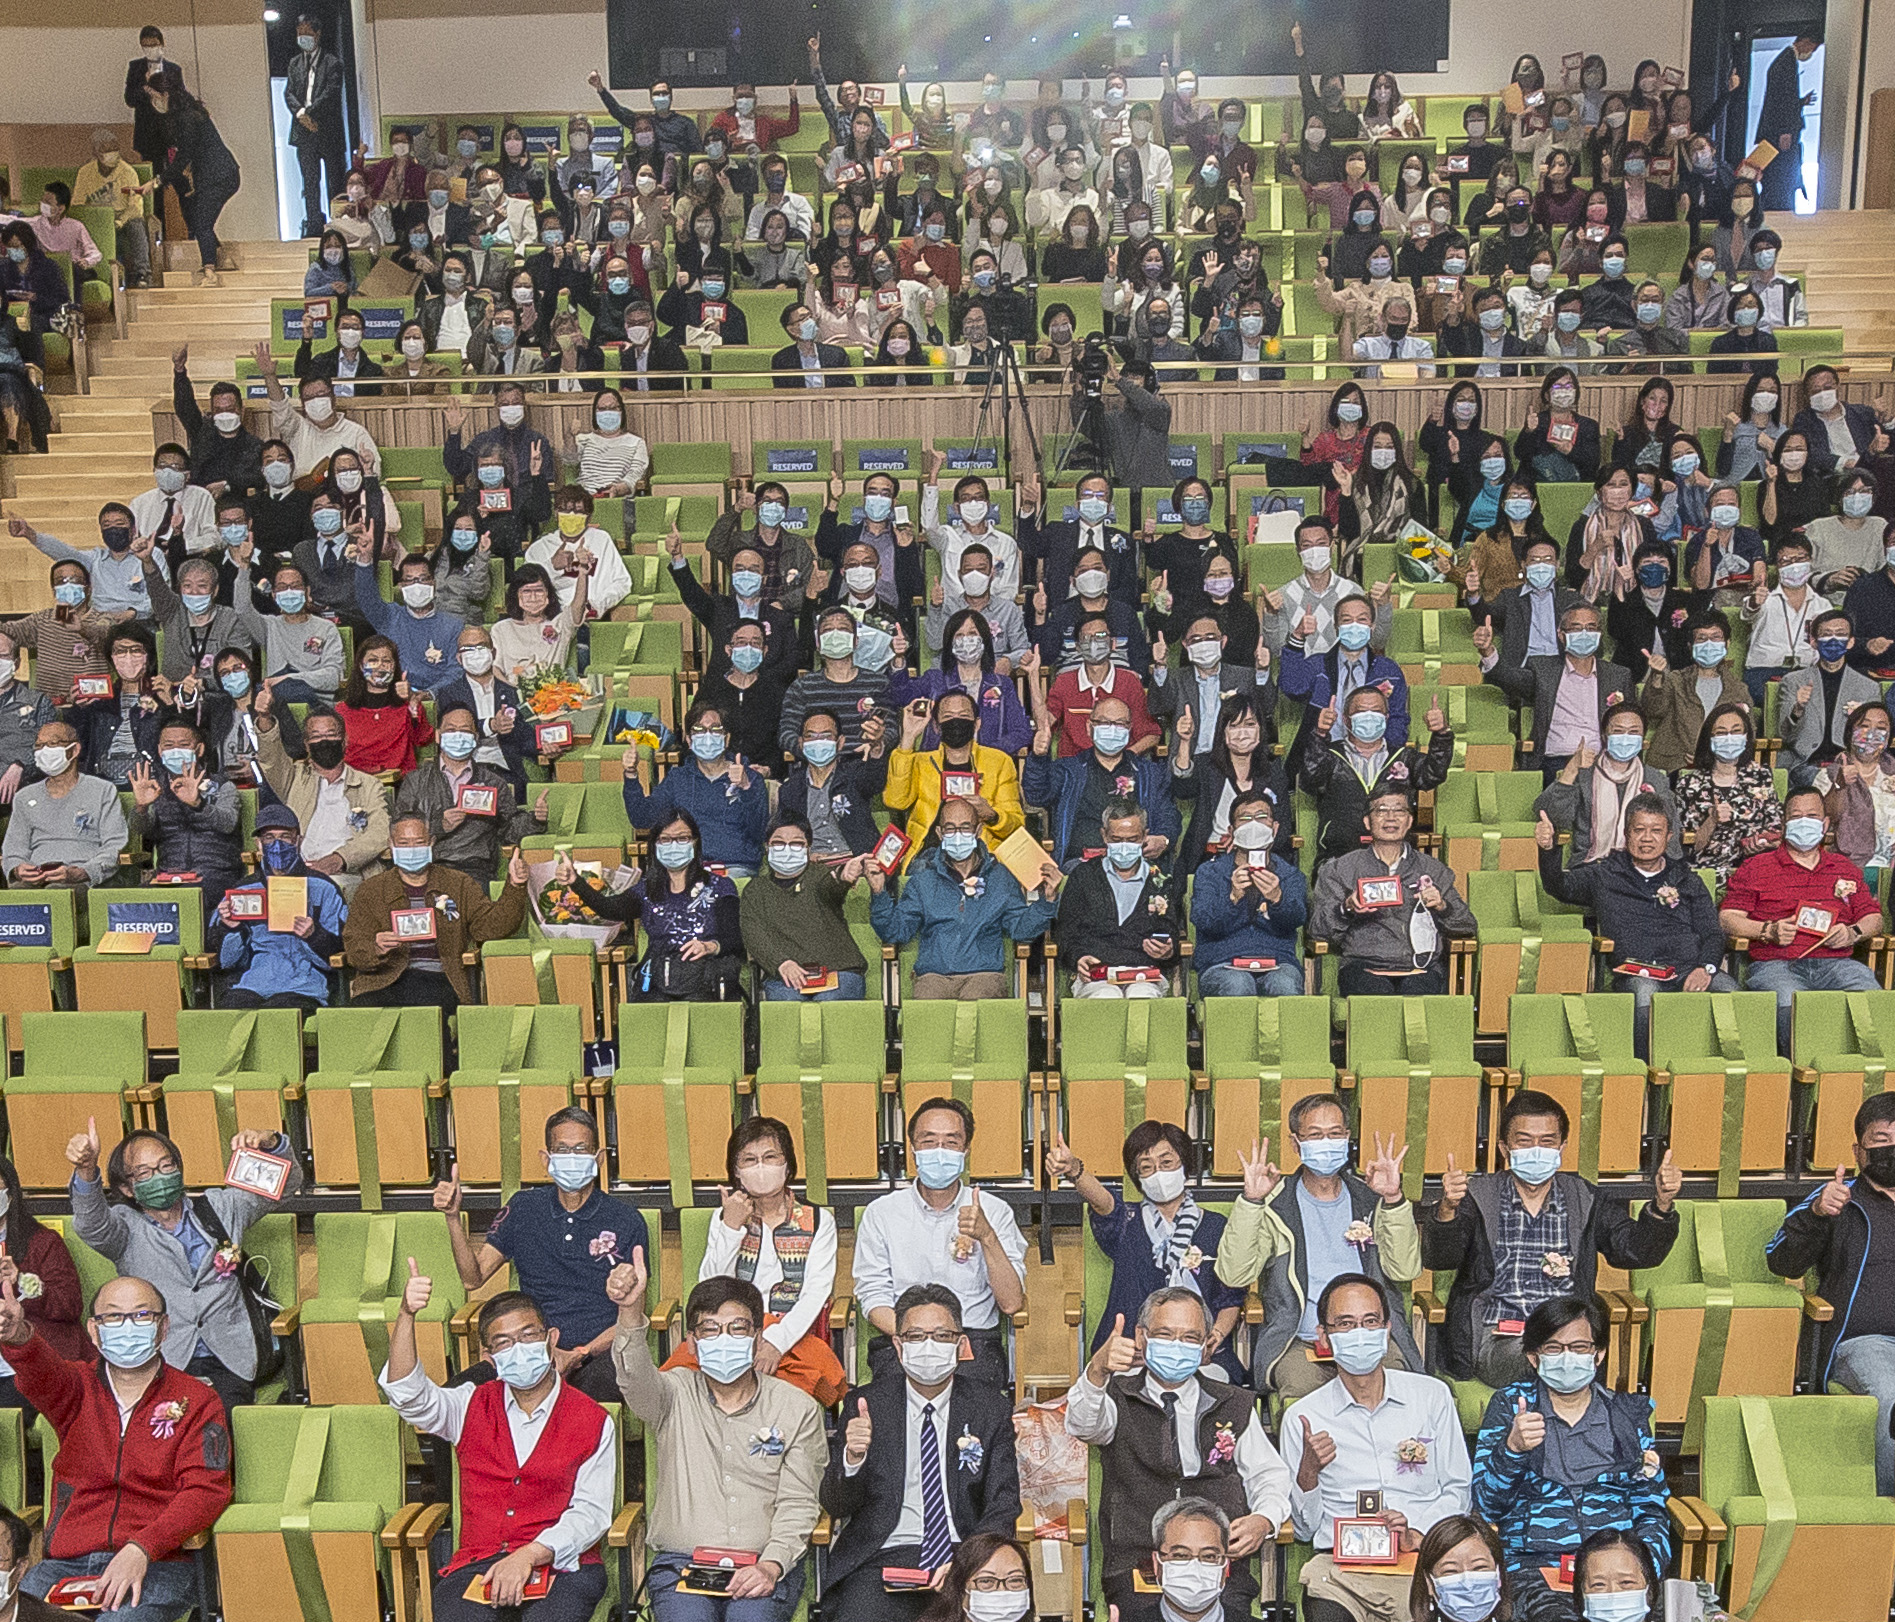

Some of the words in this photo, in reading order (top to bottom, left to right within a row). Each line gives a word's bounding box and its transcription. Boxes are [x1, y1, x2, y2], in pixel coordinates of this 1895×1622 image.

[365, 320, 401, 328] RESERVED
[772, 462, 814, 472] RESERVED
[863, 461, 905, 470] RESERVED
